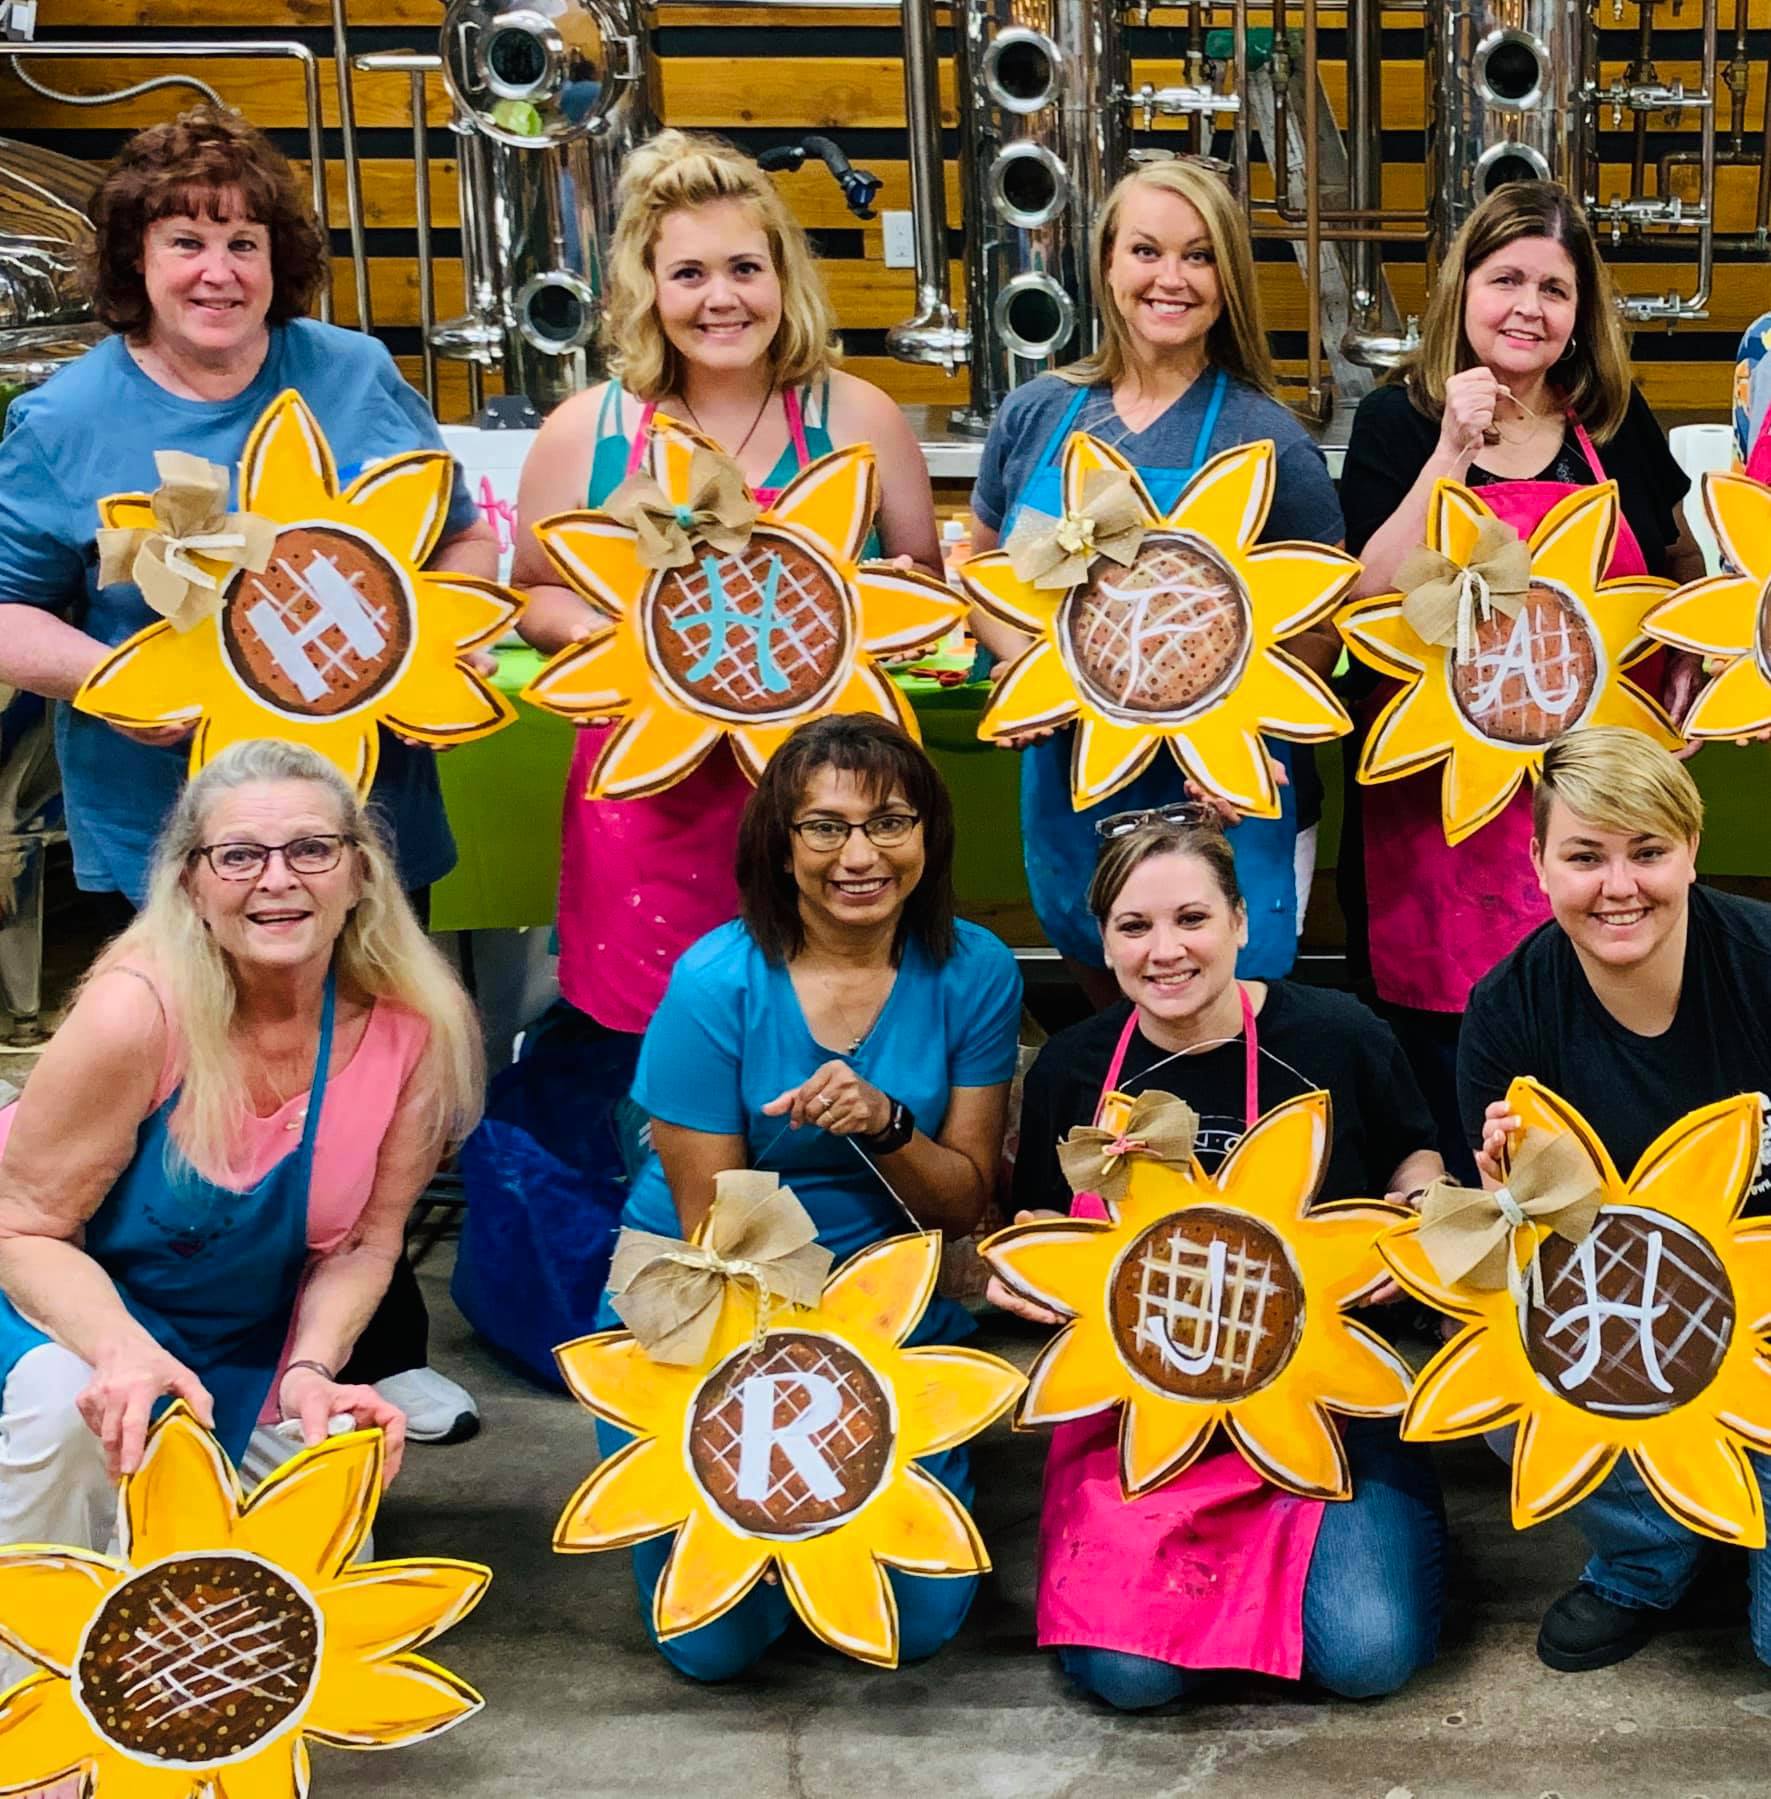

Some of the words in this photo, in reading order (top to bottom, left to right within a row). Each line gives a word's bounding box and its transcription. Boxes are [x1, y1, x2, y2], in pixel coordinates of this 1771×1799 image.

[247, 556, 388, 703] H
[669, 555, 792, 693] H
[1468, 606, 1580, 714] A
[1146, 1240, 1228, 1376] J
[1545, 1230, 1675, 1395] H
[736, 1371, 847, 1502] R
